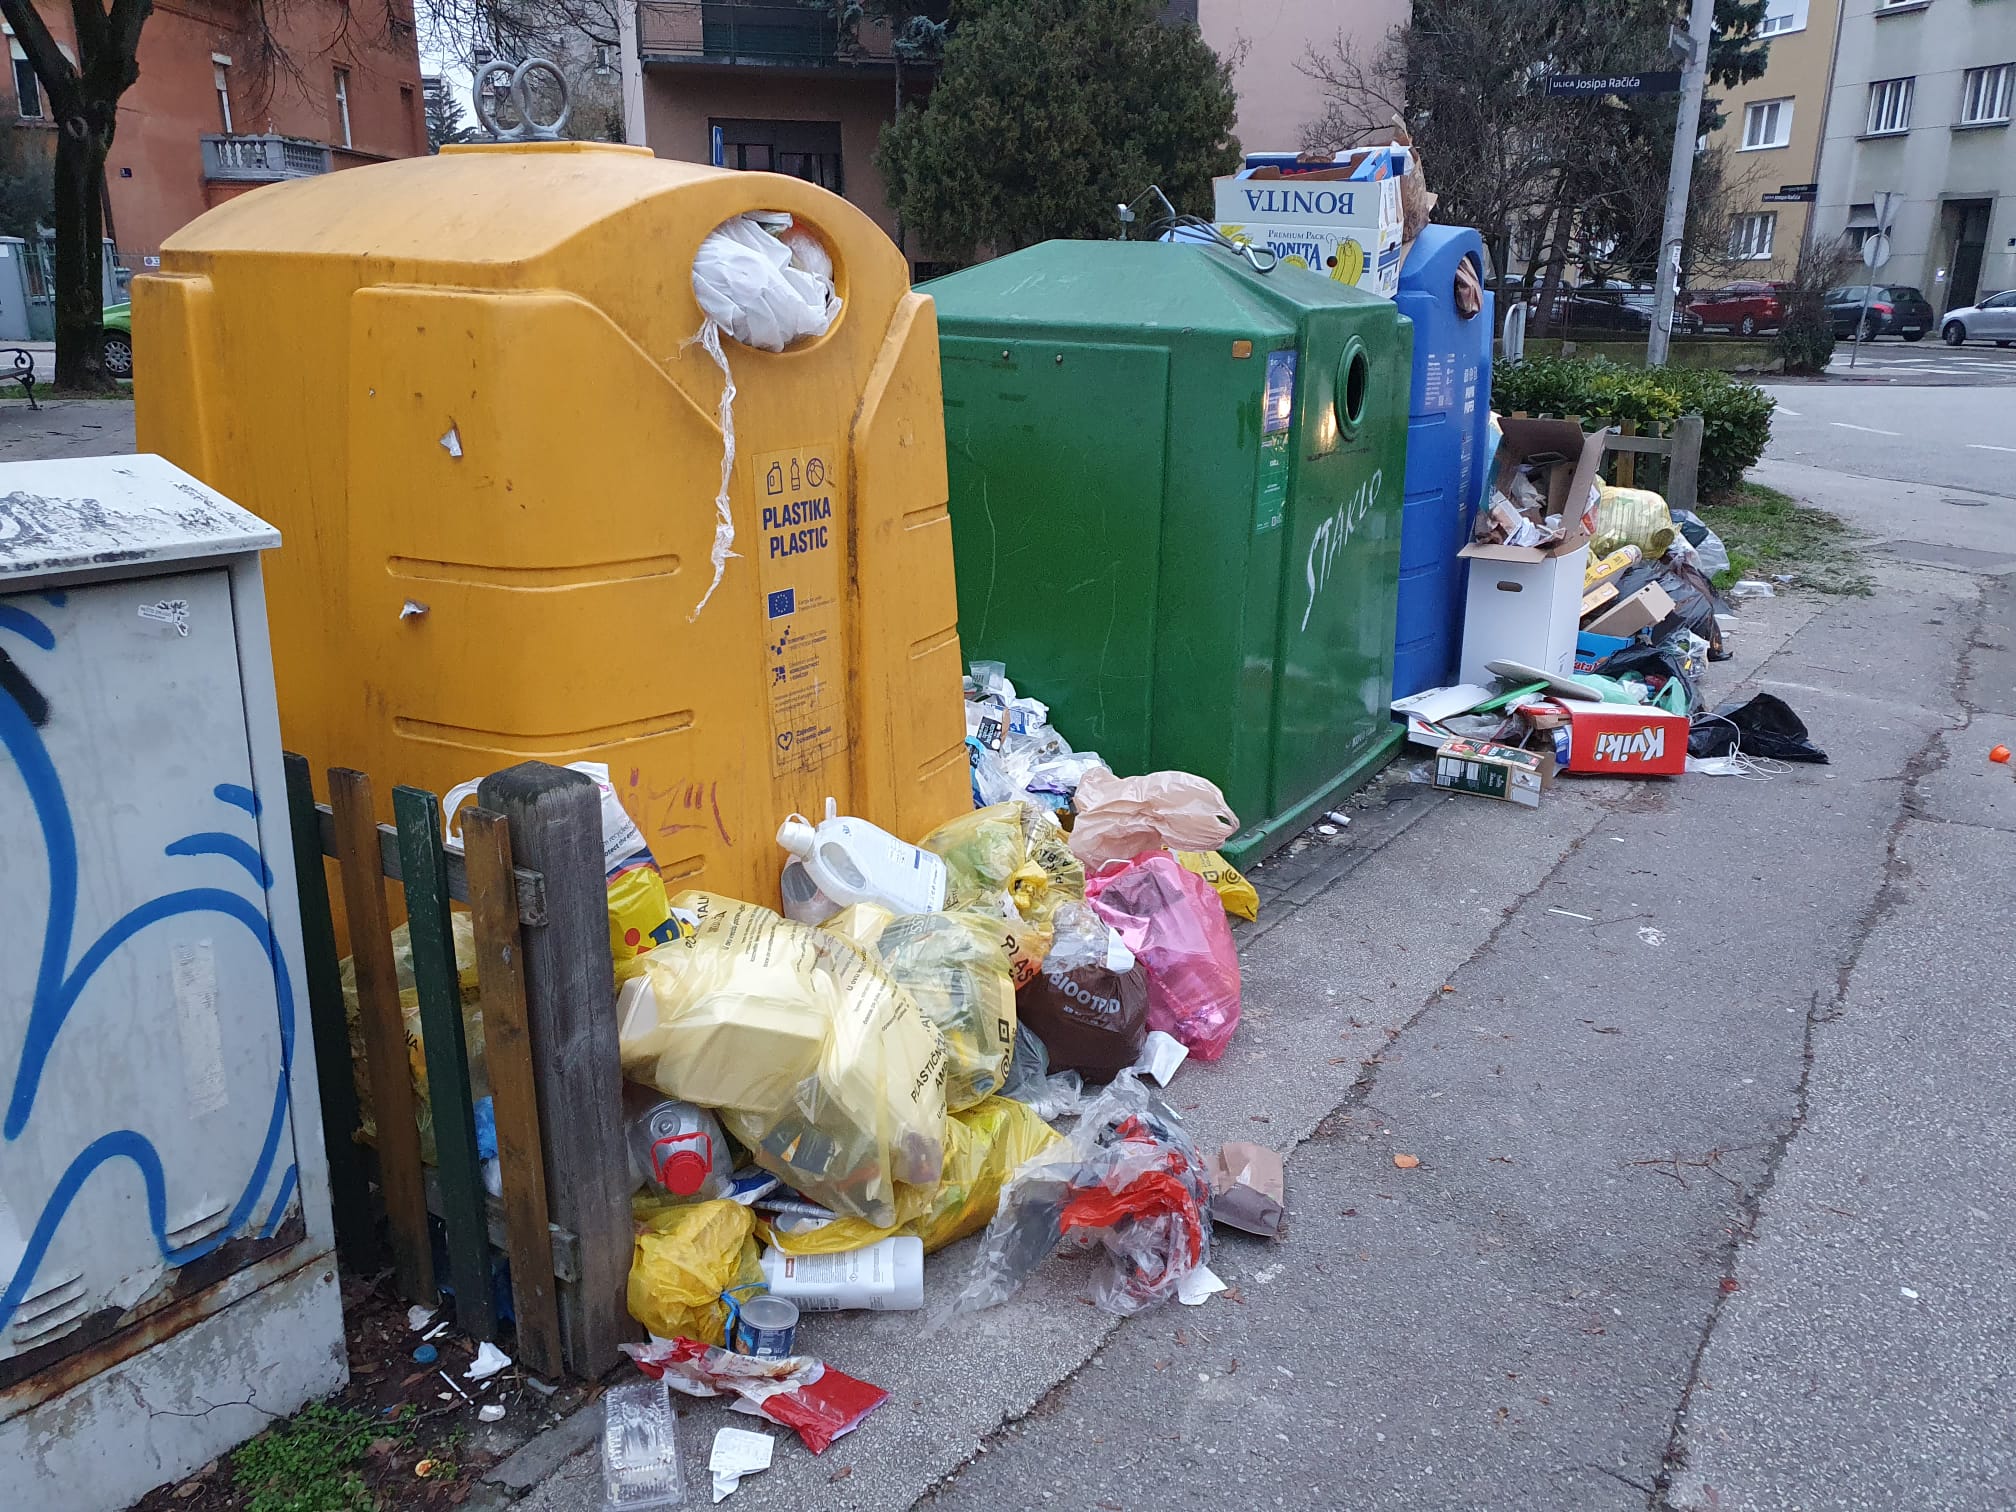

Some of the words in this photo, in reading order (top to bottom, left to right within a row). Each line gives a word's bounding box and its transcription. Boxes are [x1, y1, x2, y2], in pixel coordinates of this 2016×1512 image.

[1576, 79, 1607, 90] Josipa
[1245, 189, 1355, 215] BONITA
[1268, 229, 1305, 239] PREMIUM
[1306, 231, 1325, 240] PACK
[762, 496, 832, 531] PLASTIKA
[769, 525, 829, 559] PLASTIC
[1594, 726, 1665, 762] Kviki
